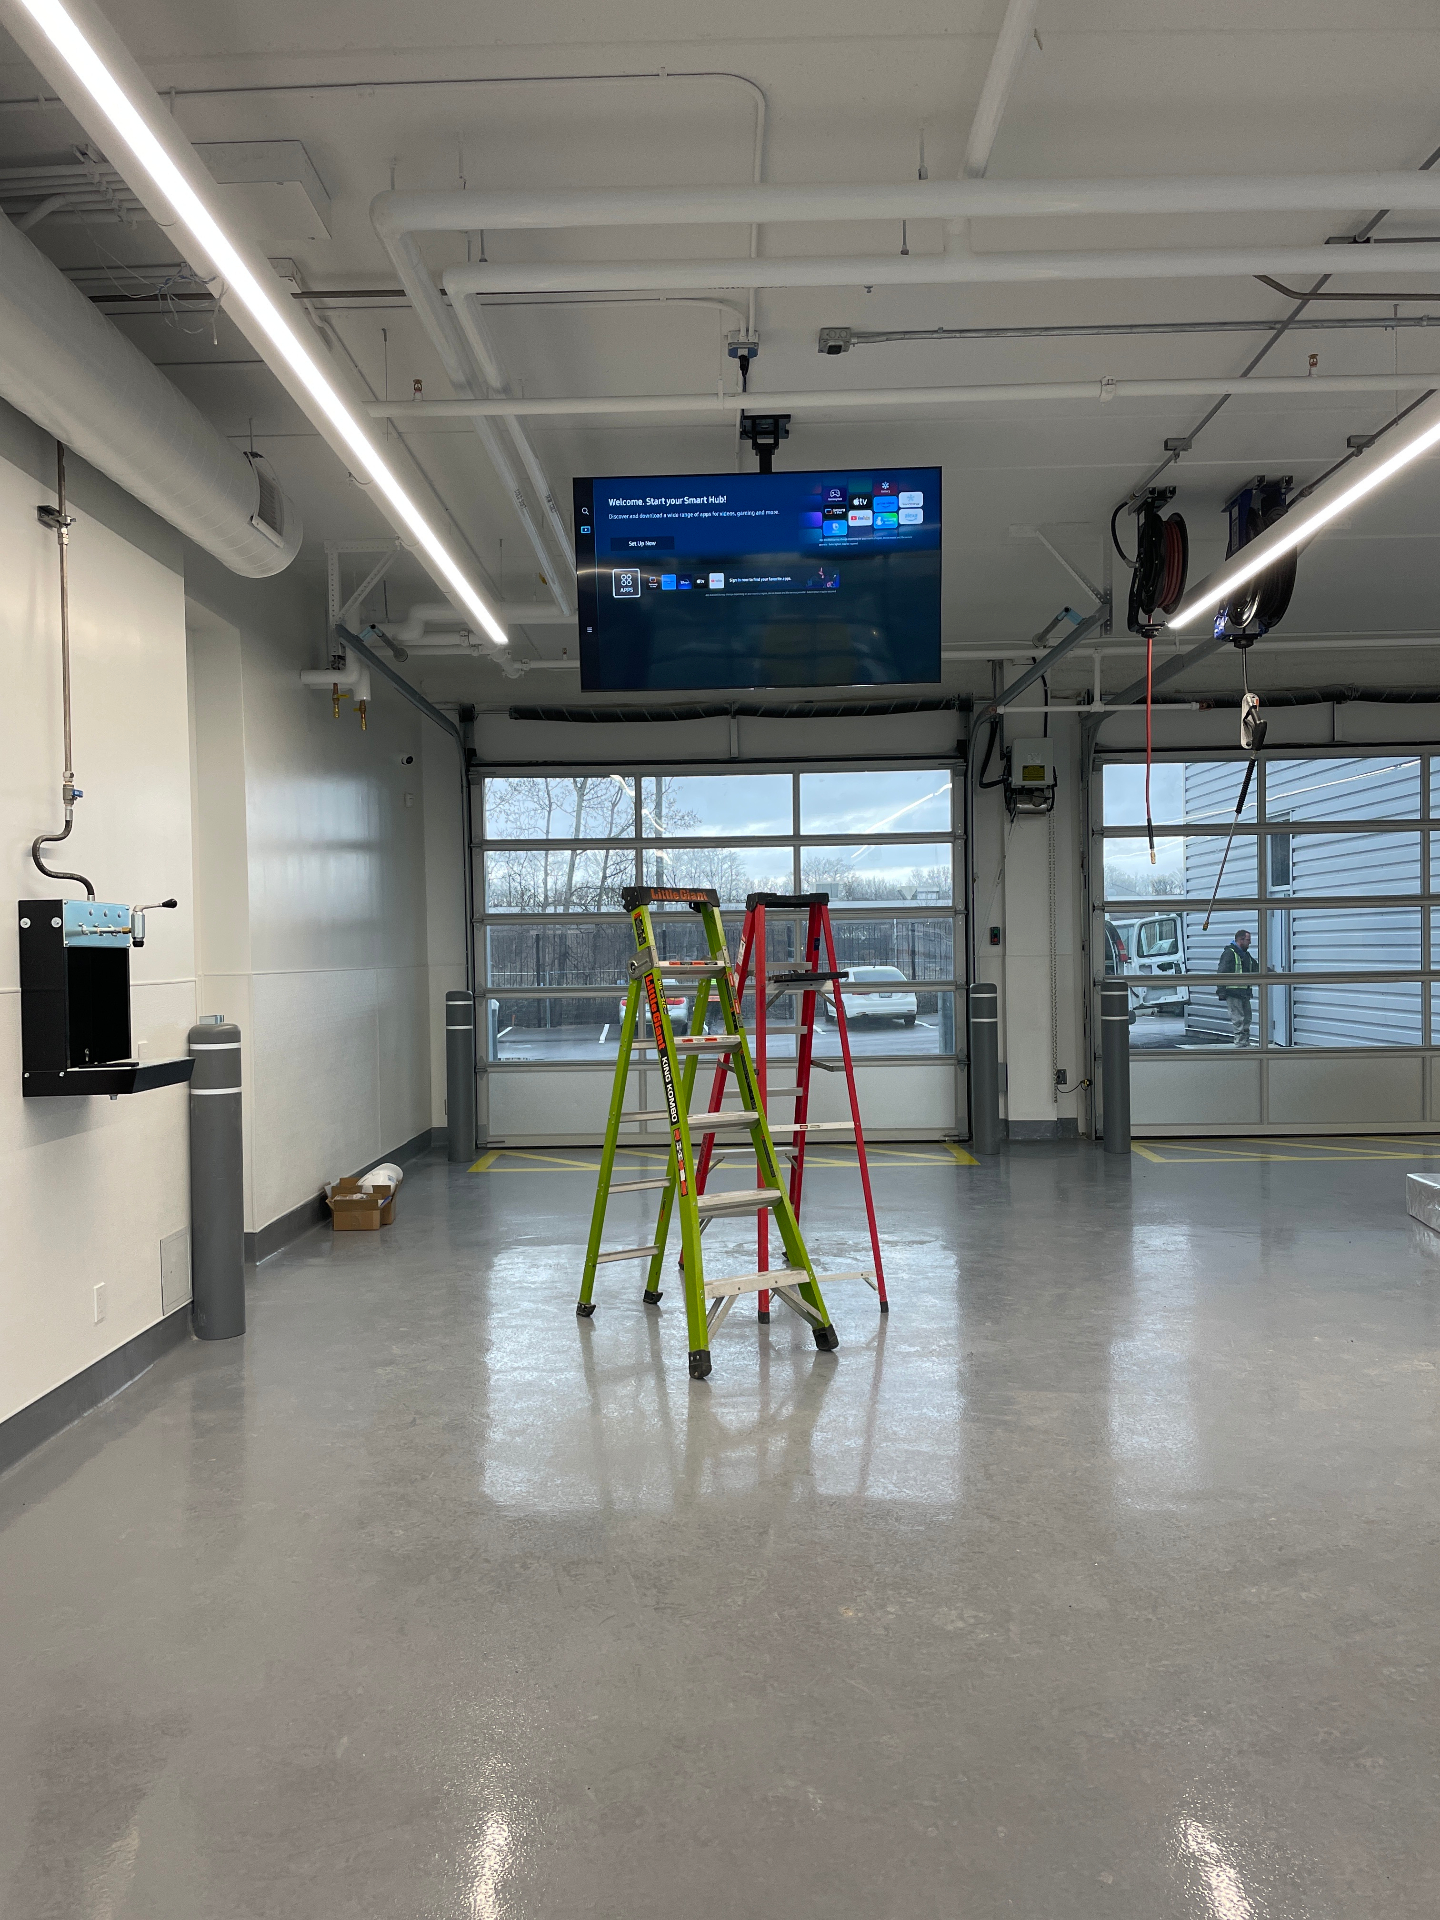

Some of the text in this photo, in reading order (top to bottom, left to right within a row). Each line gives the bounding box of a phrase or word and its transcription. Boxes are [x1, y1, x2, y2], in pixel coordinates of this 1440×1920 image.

[609, 498, 645, 507] Welcome.
[684, 496, 708, 505] Smart
[709, 495, 727, 504] Hub!
[637, 540, 644, 548] Up
[650, 888, 709, 901] Little Giant
[645, 974, 658, 1013] Little
[652, 1011, 666, 1050] Giant
[661, 1056, 678, 1122] KING KOMBO
